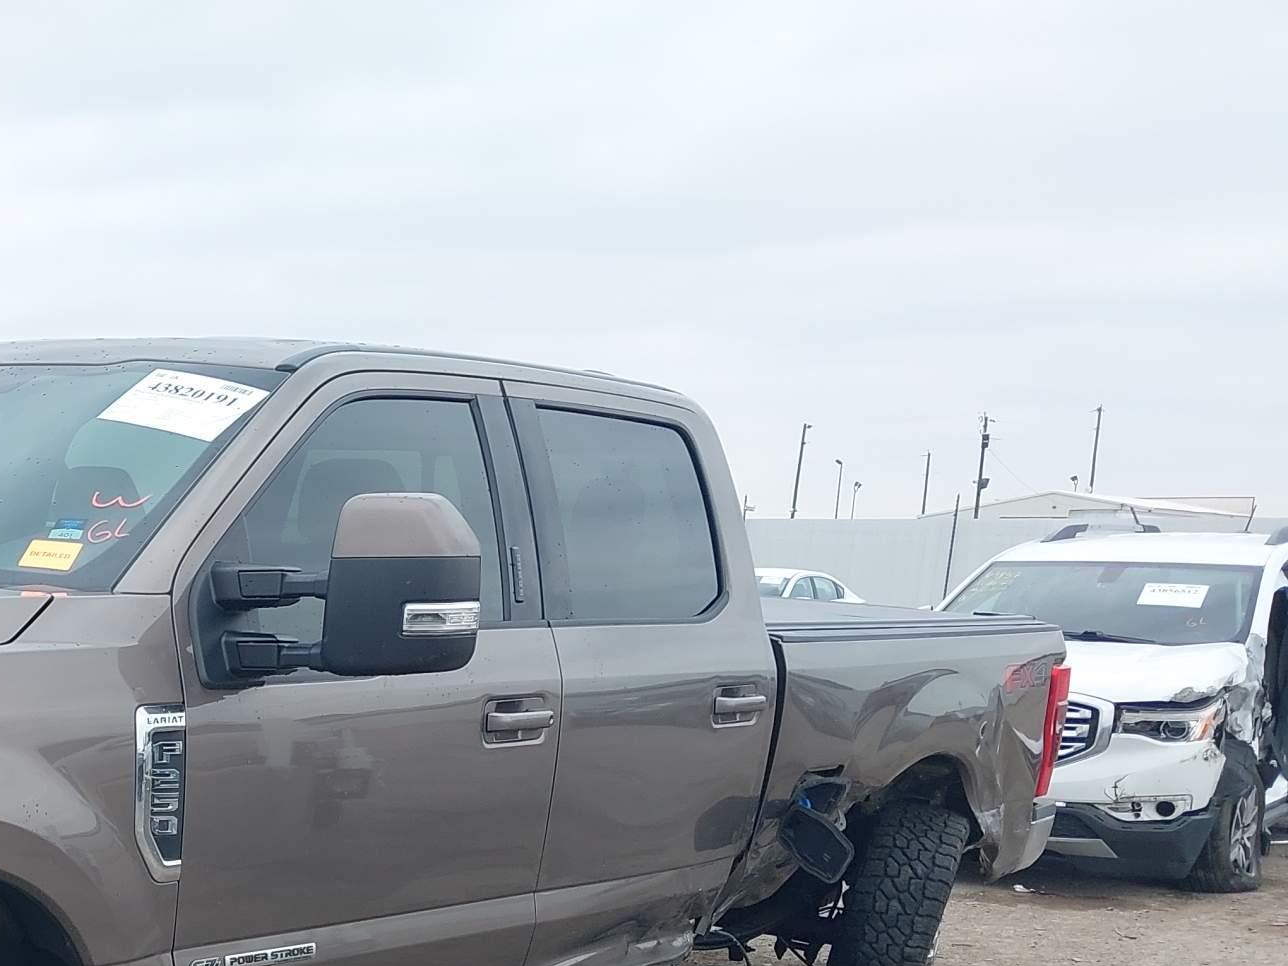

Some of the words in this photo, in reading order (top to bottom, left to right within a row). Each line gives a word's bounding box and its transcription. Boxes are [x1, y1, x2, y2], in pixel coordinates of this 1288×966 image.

[148, 381, 239, 407] 43820191
[1002, 662, 1049, 695] FX4
[147, 715, 184, 725] LARIAT
[229, 953, 269, 966] POWER
[270, 945, 314, 960] STROKE
